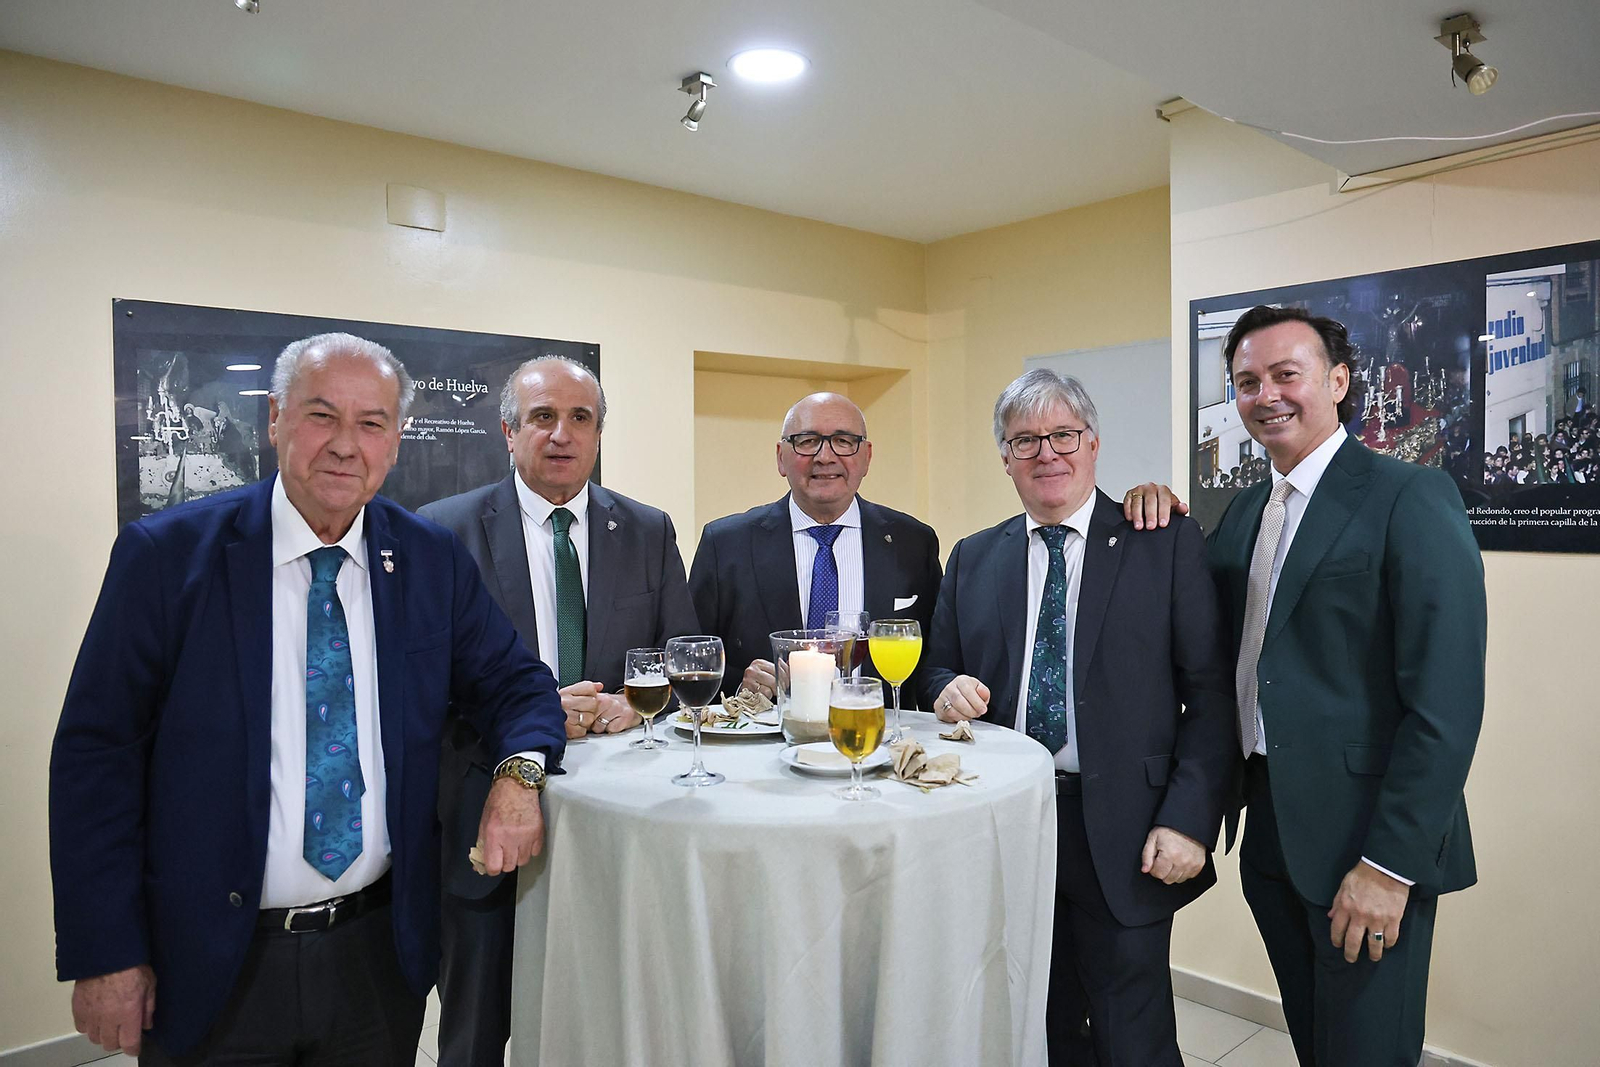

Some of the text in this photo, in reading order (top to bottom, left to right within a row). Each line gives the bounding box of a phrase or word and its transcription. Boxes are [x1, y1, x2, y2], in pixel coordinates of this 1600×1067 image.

[1487, 333, 1546, 375] juventud
[428, 377, 444, 390] de
[446, 378, 489, 394] Huelva
[1476, 507, 1512, 516] Redondo,
[1531, 507, 1539, 515] el
[1539, 507, 1571, 518] popular
[1498, 518, 1508, 526] de
[1509, 518, 1516, 526] la
[1517, 518, 1549, 527] primera
[1550, 518, 1577, 527] capilla
[1578, 518, 1589, 526] de
[1590, 518, 1598, 526] la
